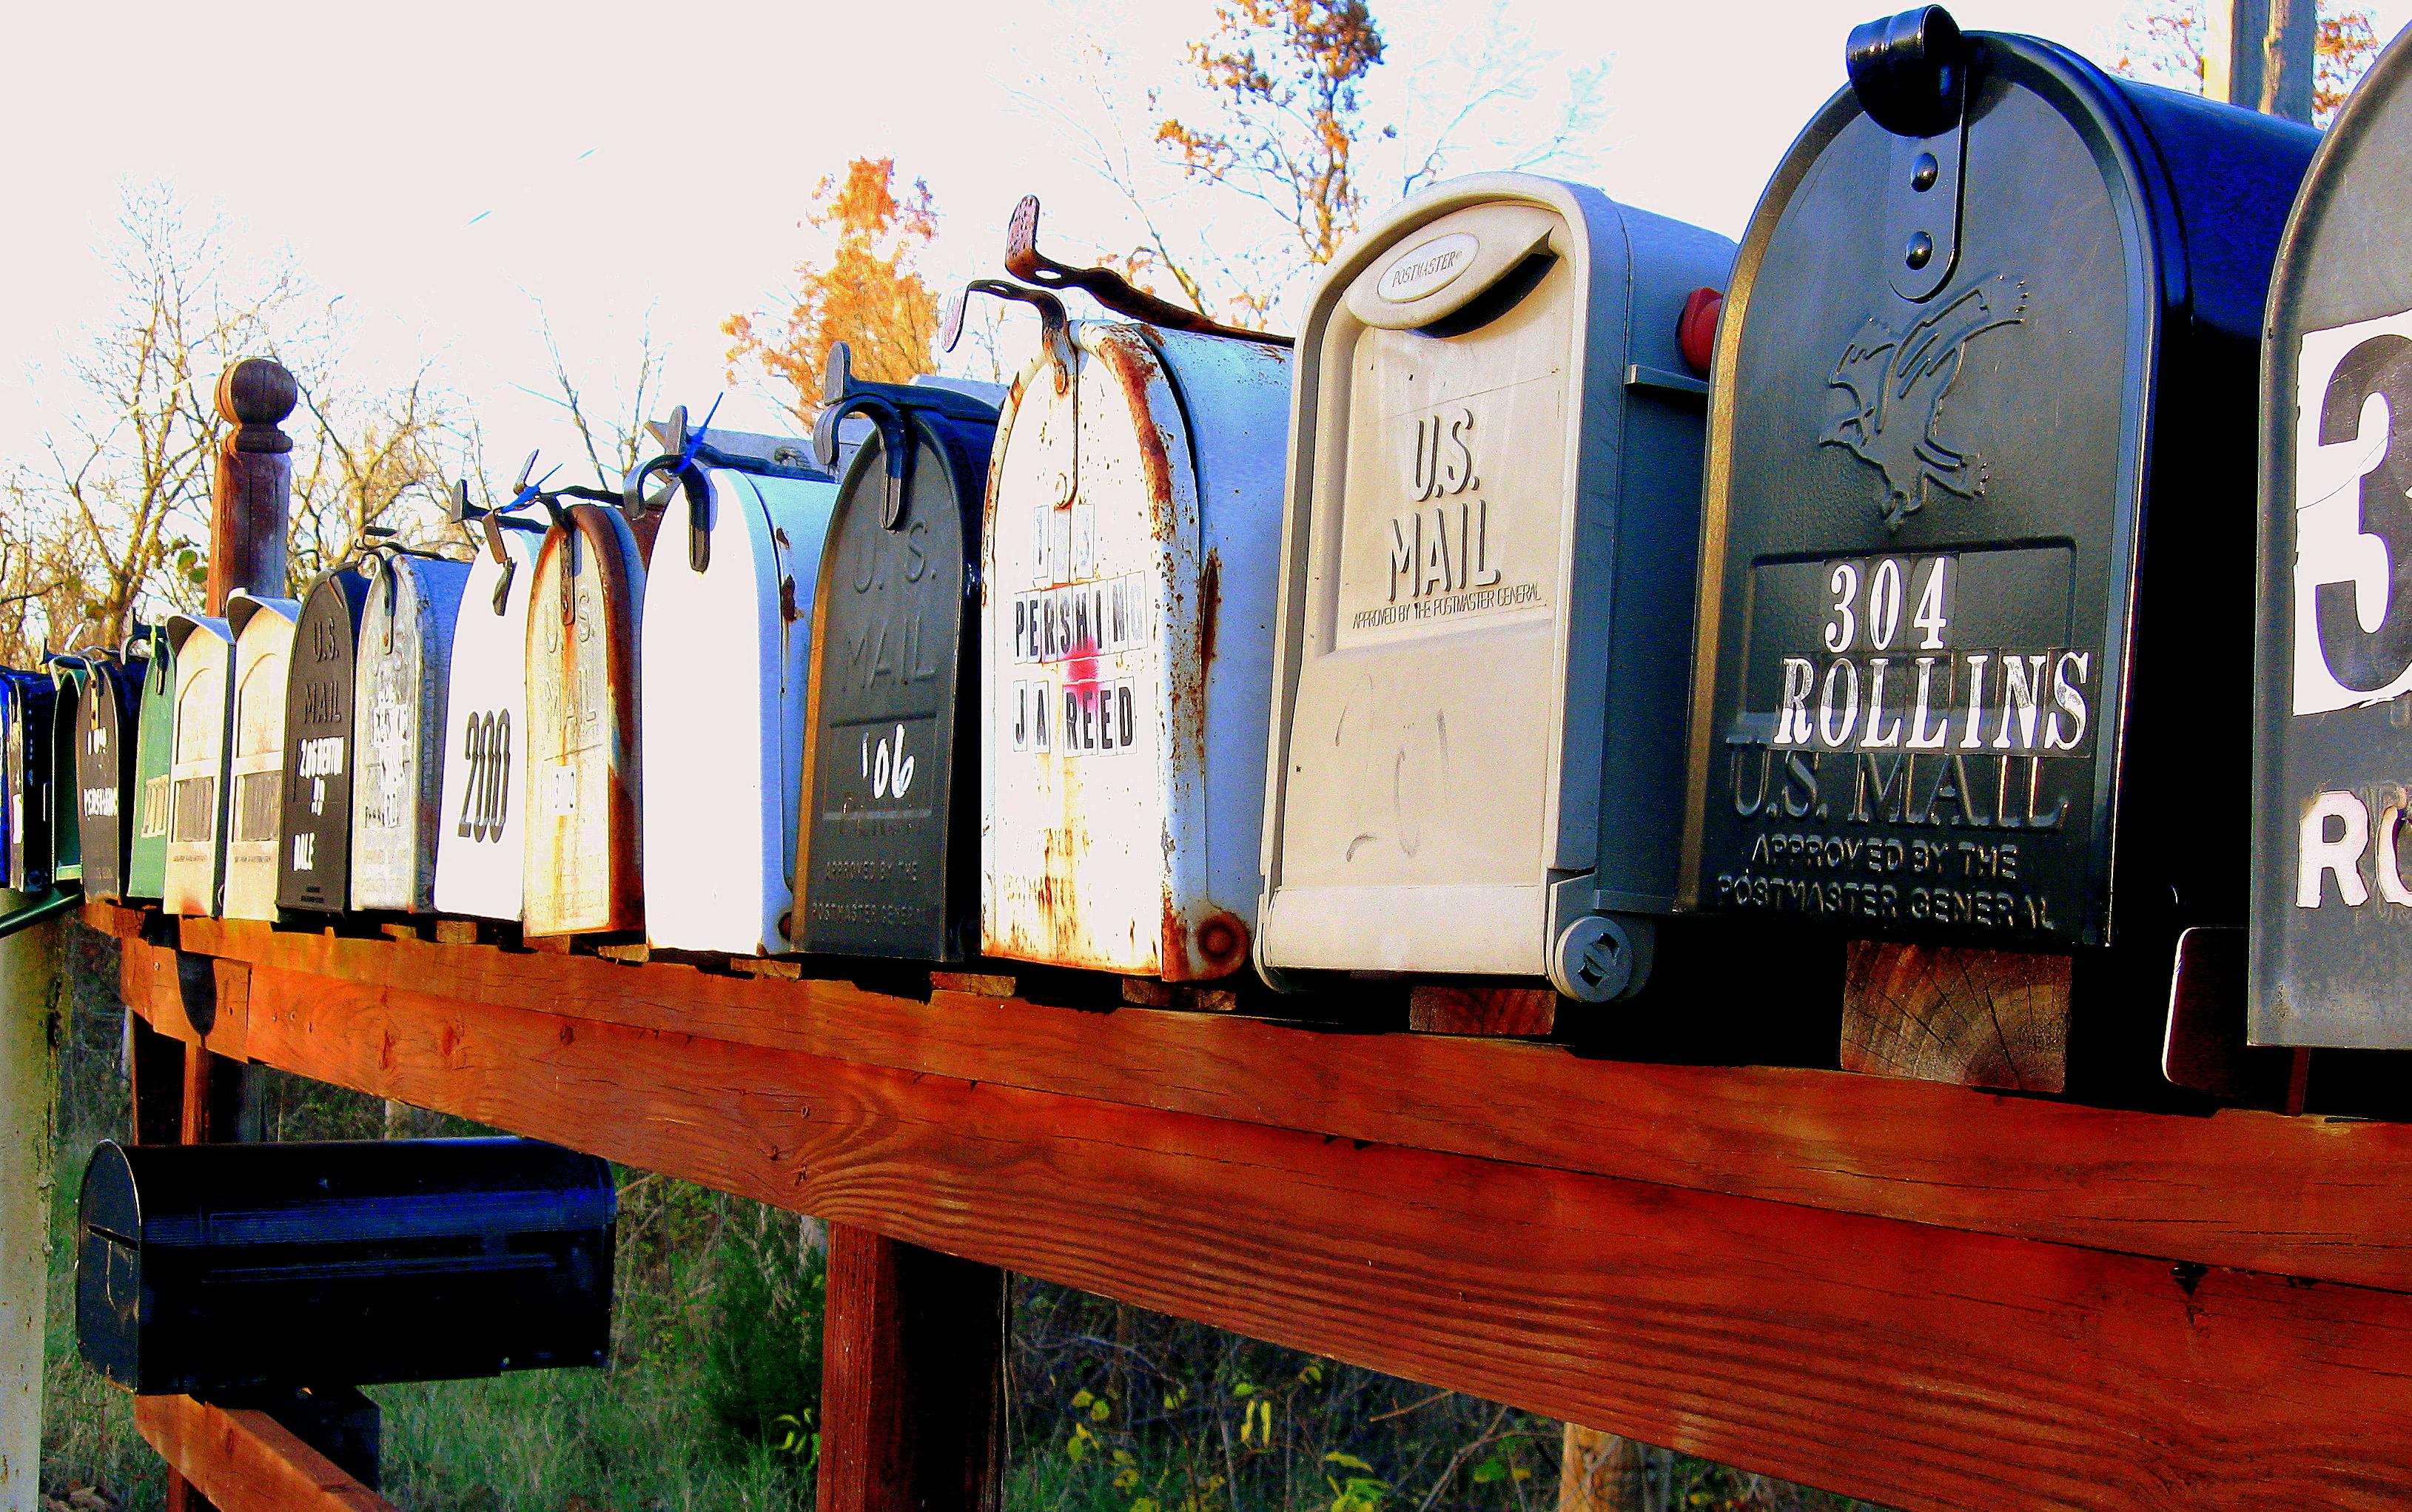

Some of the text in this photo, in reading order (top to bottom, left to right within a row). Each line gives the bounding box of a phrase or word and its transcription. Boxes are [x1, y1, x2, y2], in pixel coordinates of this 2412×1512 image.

[1391, 251, 1457, 287] POSTMASTER
[1410, 408, 1480, 502] U.S.
[852, 518, 937, 594] U.S.
[1388, 500, 1501, 602] MAIL
[1015, 583, 1144, 658] PERSHING
[1353, 582, 1542, 629] APPROVED BY THE POSTMASTER GENERAL
[1824, 557, 1947, 653] 304
[844, 614, 937, 692] MAIL
[304, 680, 342, 724] MAIL
[1015, 685, 1132, 751] J A REED
[1773, 651, 2089, 750] ROLLINS
[457, 708, 511, 844] 200
[1724, 735, 2071, 834] U.S. MAIL
[1751, 833, 2020, 880] APPROVED BY THE
[1717, 873, 1899, 918] POSTMASTER
